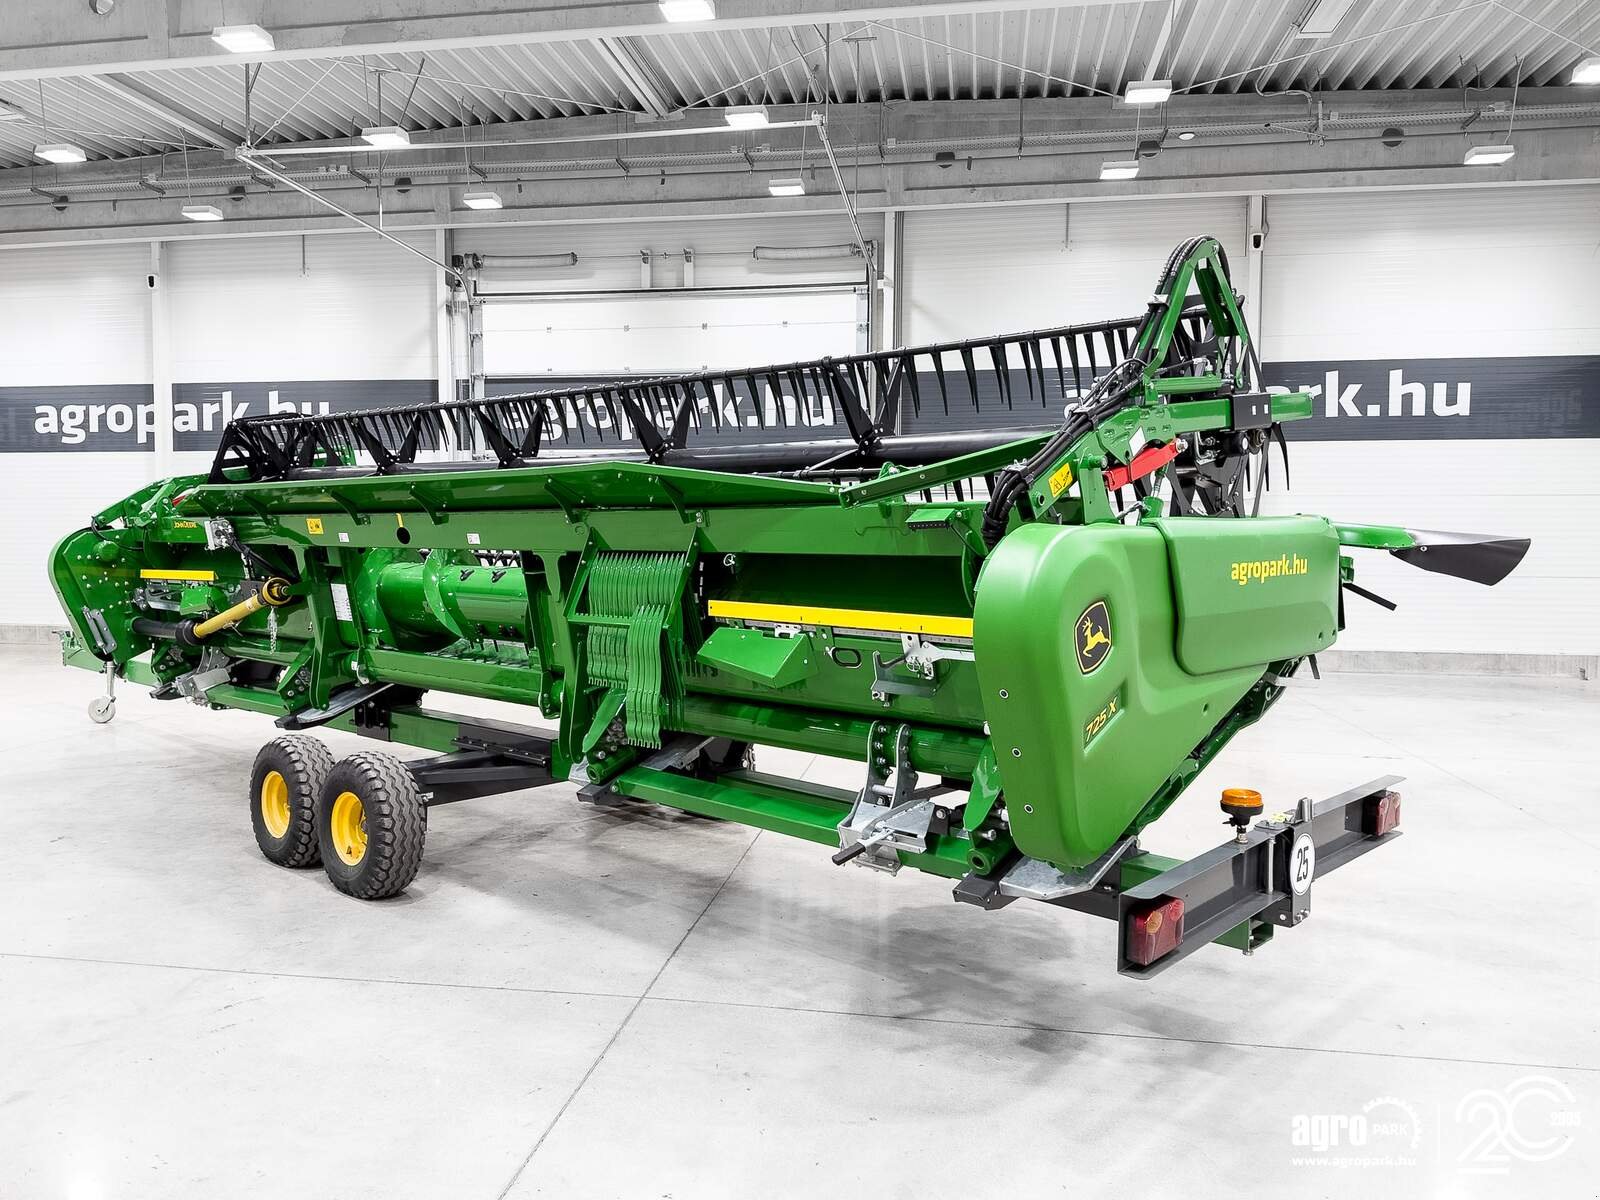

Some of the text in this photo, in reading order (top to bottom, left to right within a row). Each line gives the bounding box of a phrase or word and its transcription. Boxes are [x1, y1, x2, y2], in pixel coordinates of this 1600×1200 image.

[34, 390, 330, 444] agroparkh
[1231, 553, 1308, 586] agropark.hu
[1296, 845, 1309, 882] 25
